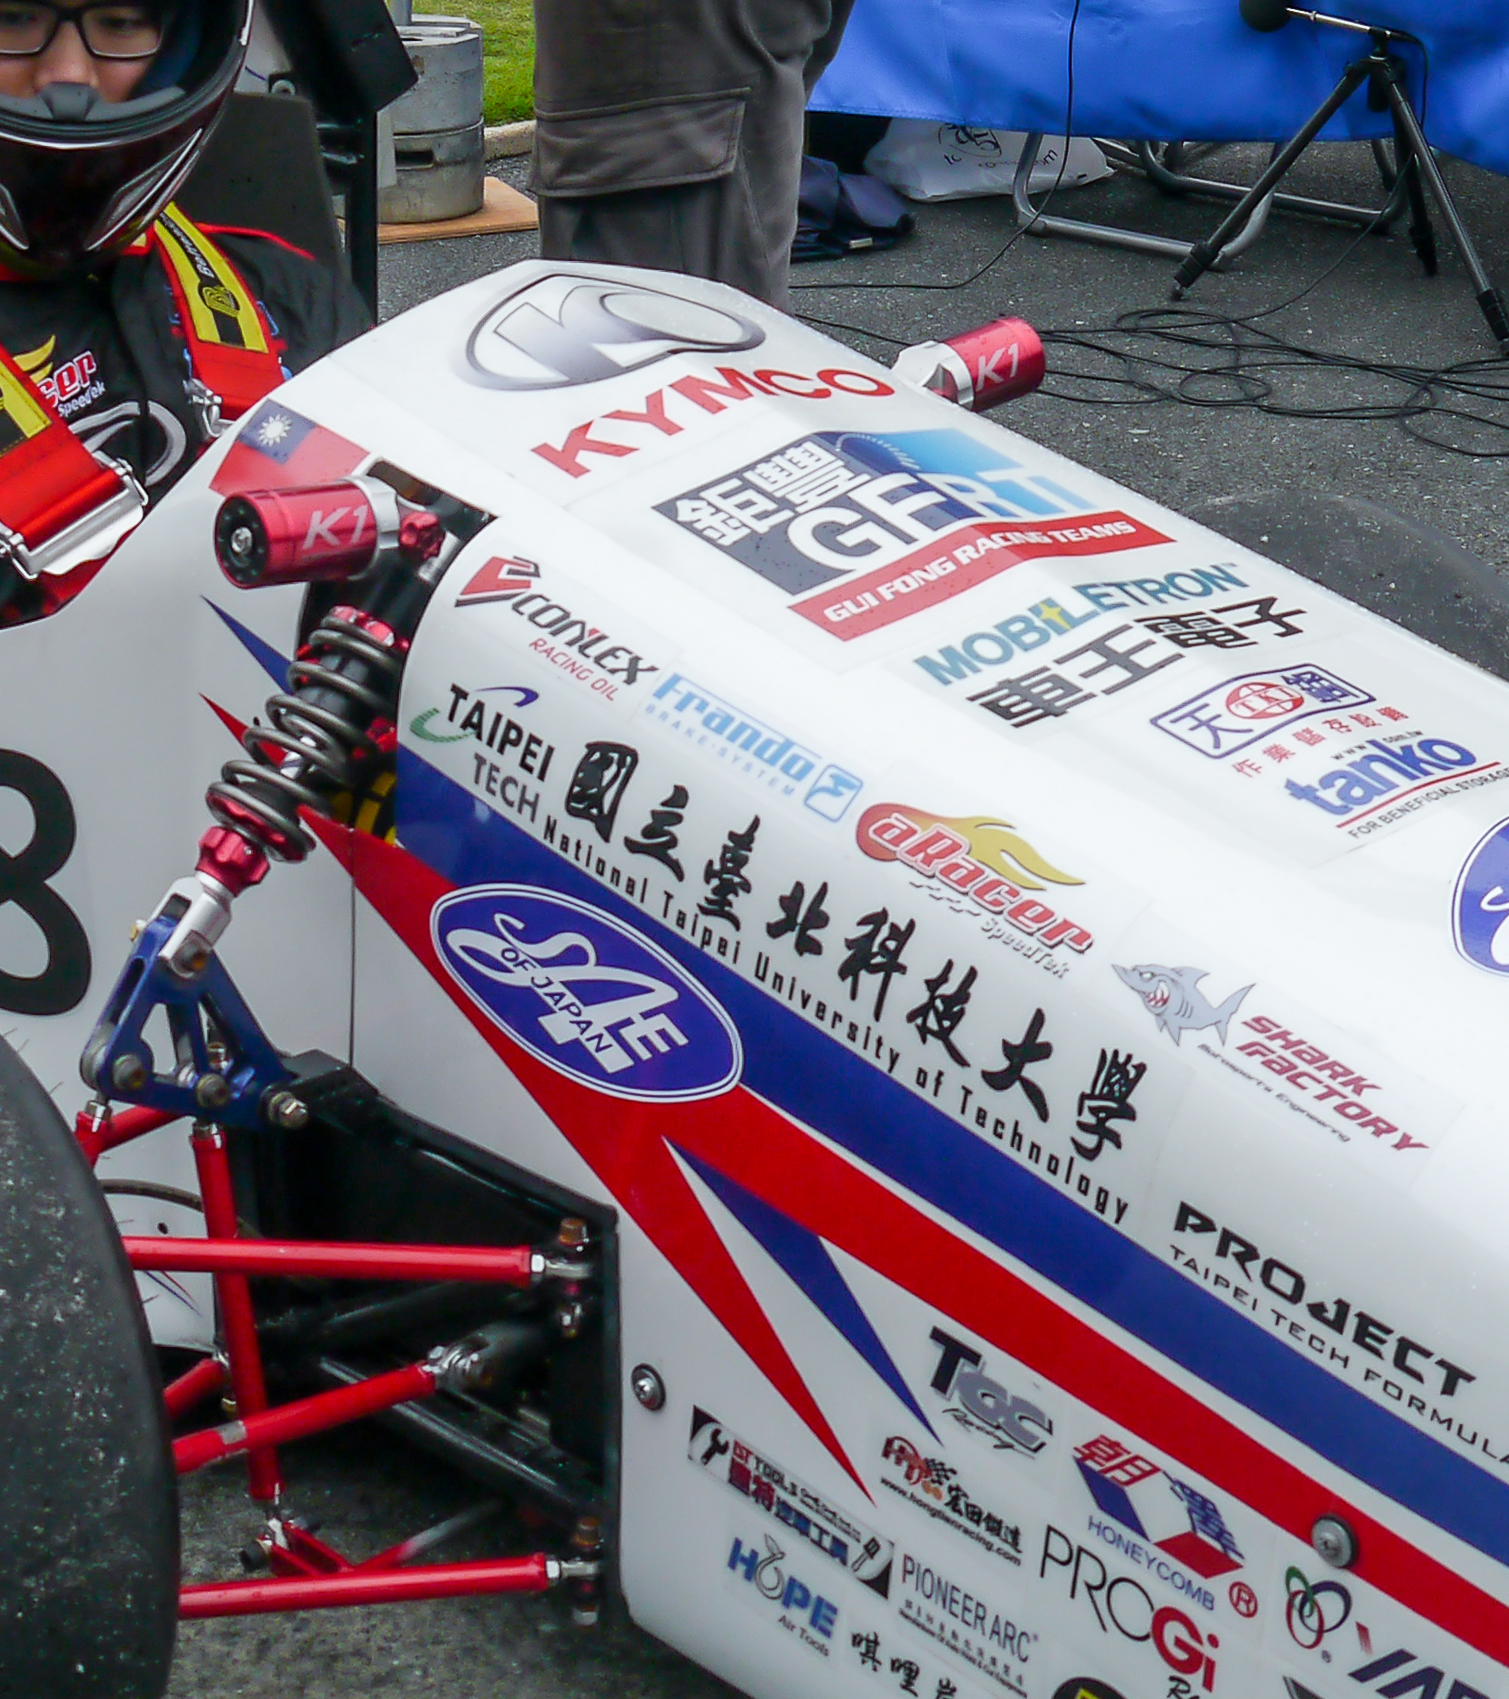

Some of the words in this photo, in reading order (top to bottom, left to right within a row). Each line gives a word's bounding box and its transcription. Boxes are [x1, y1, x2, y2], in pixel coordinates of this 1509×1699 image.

[977, 342, 1020, 386] K1
[531, 366, 894, 478] KYMCO
[302, 504, 368, 550] K1
[823, 589, 879, 623] GUI
[880, 562, 956, 601] FONG
[960, 529, 1050, 566] RACING
[1049, 521, 1137, 544] TEAMS
[529, 638, 594, 681] RACING
[590, 668, 619, 701] OIL
[966, 596, 1308, 730] 車王電子
[446, 683, 554, 782] TAIPEI
[653, 672, 816, 781] Frando
[1283, 738, 1476, 816] tanko
[473, 753, 539, 823] TECH
[1348, 818, 1380, 839] FOR
[1379, 785, 1457, 825] BENEFICIAL
[499, 946, 529, 977] OF
[530, 976, 610, 1055] JAPAN
[566, 741, 1149, 1163] 國立臺北科技大學
[544, 813, 649, 906] National
[662, 888, 741, 967] Taipei
[754, 946, 900, 1075] University
[915, 1065, 943, 1099] of
[959, 1085, 1129, 1224] Technology
[1167, 1243, 1260, 1312] TAIPEI
[1269, 1308, 1350, 1370] TECH
[1172, 1200, 1478, 1397] PROJECT
[902, 1554, 988, 1637] PIONEER
[989, 1614, 1030, 1663] ARC
[1087, 1514, 1216, 1612] HONEYCOMB
[778, 1614, 796, 1632] Air
[799, 1626, 830, 1657] Tools
